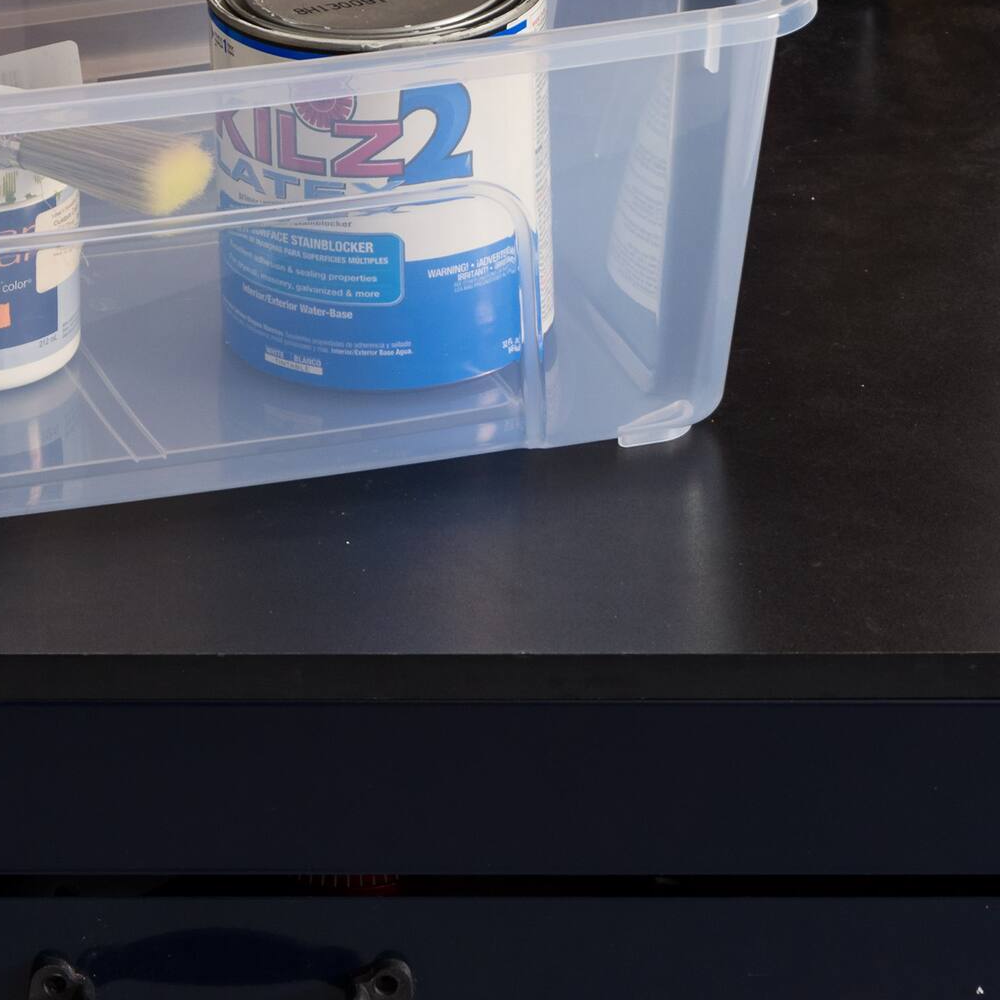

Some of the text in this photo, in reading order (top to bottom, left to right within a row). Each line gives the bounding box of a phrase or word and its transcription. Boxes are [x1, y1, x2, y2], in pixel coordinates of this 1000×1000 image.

[399, 82, 473, 187] 2
[291, 235, 375, 254] STAINBLOCKER
[295, 267, 326, 280] sealing
[328, 272, 378, 283] properties
[428, 263, 469, 278] WARNING!
[2, 278, 28, 294] color
[296, 282, 343, 297] galvanized
[299, 303, 353, 320] Water-Base
[294, 353, 322, 367] BLANCO
